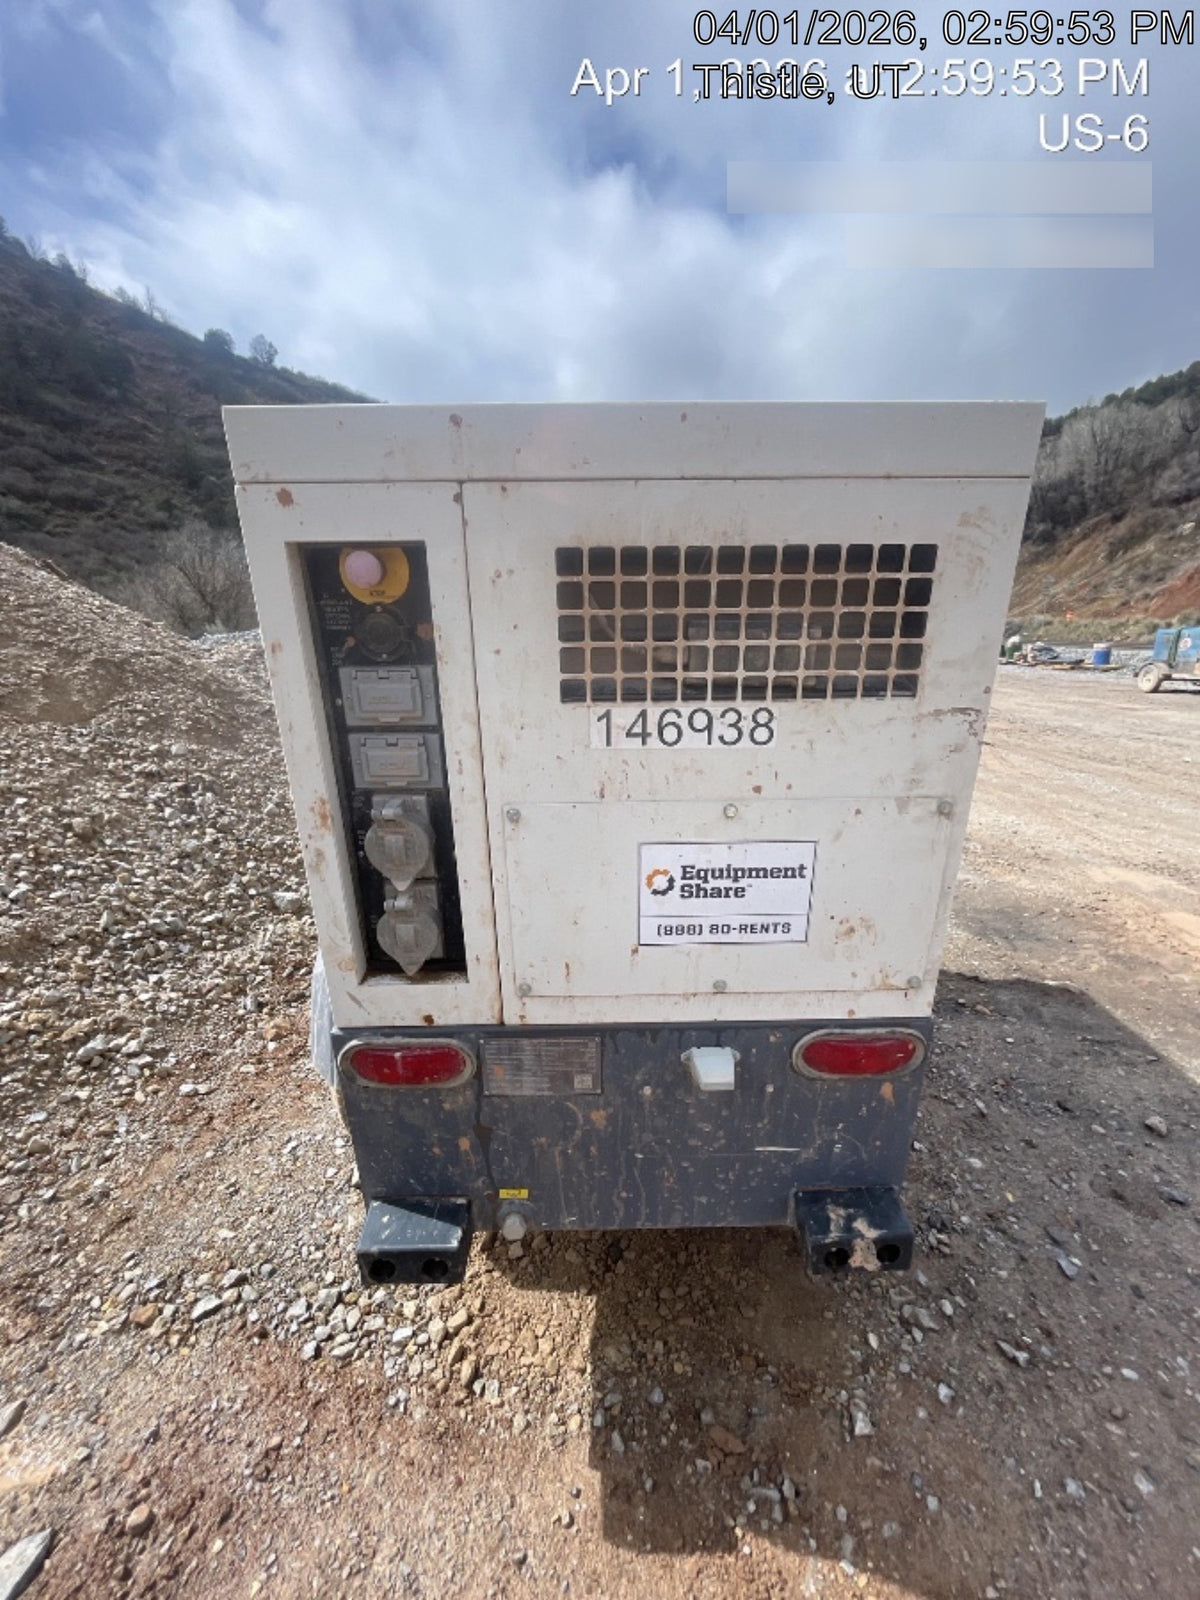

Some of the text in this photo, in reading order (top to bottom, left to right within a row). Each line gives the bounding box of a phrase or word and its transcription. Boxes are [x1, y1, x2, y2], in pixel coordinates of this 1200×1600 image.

[597, 707, 775, 747] 146938
[680, 863, 807, 883] Equipment
[680, 884, 747, 899] Share
[657, 923, 704, 936] (888)
